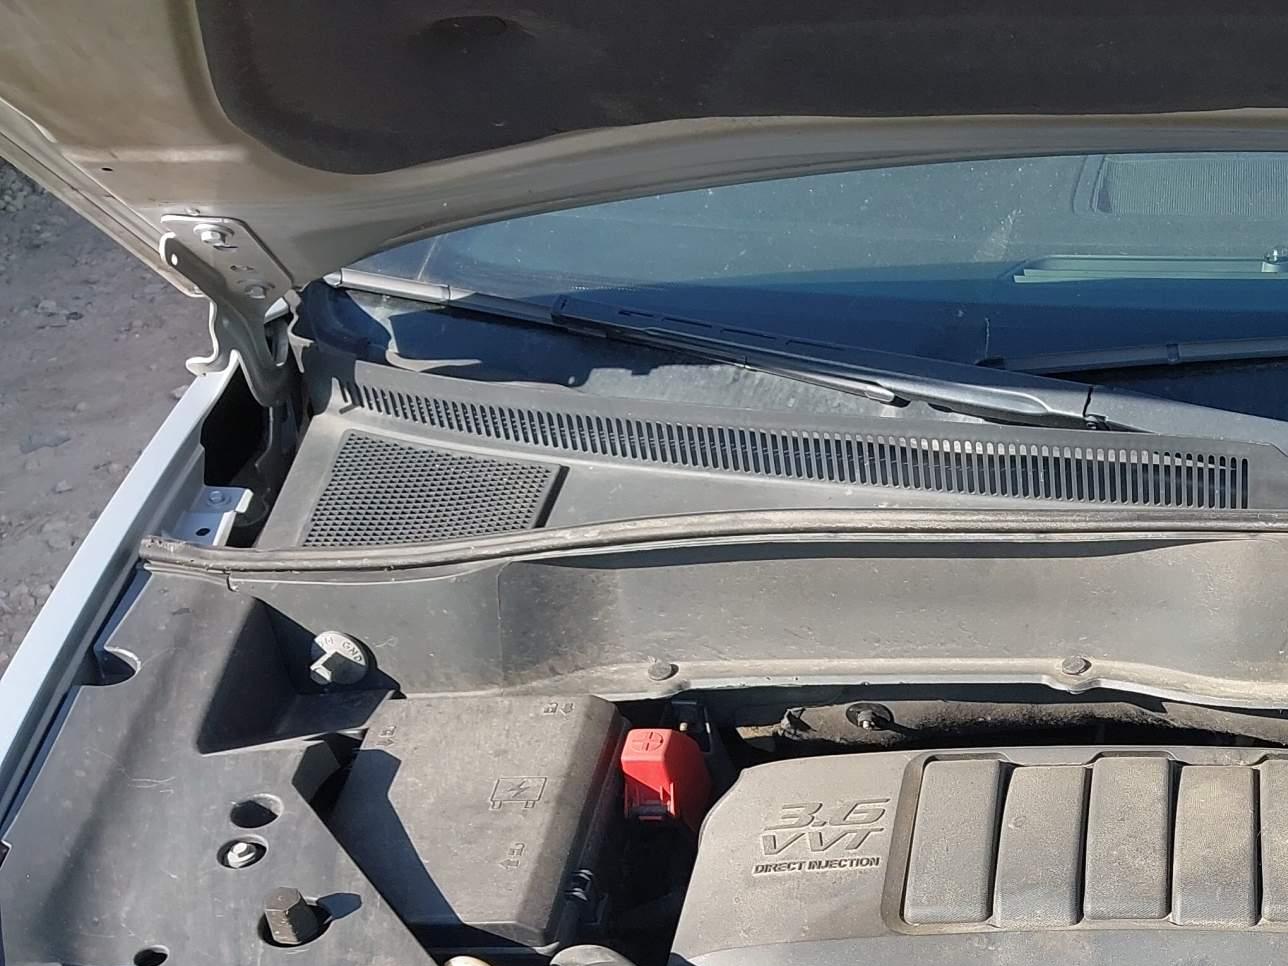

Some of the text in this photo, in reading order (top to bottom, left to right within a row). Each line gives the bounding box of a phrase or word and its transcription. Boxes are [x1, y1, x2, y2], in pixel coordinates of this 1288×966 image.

[341, 640, 363, 662] GND
[763, 798, 891, 831] 3.6
[760, 827, 885, 856] VVT
[753, 856, 880, 876] DIRECT INJECTION
